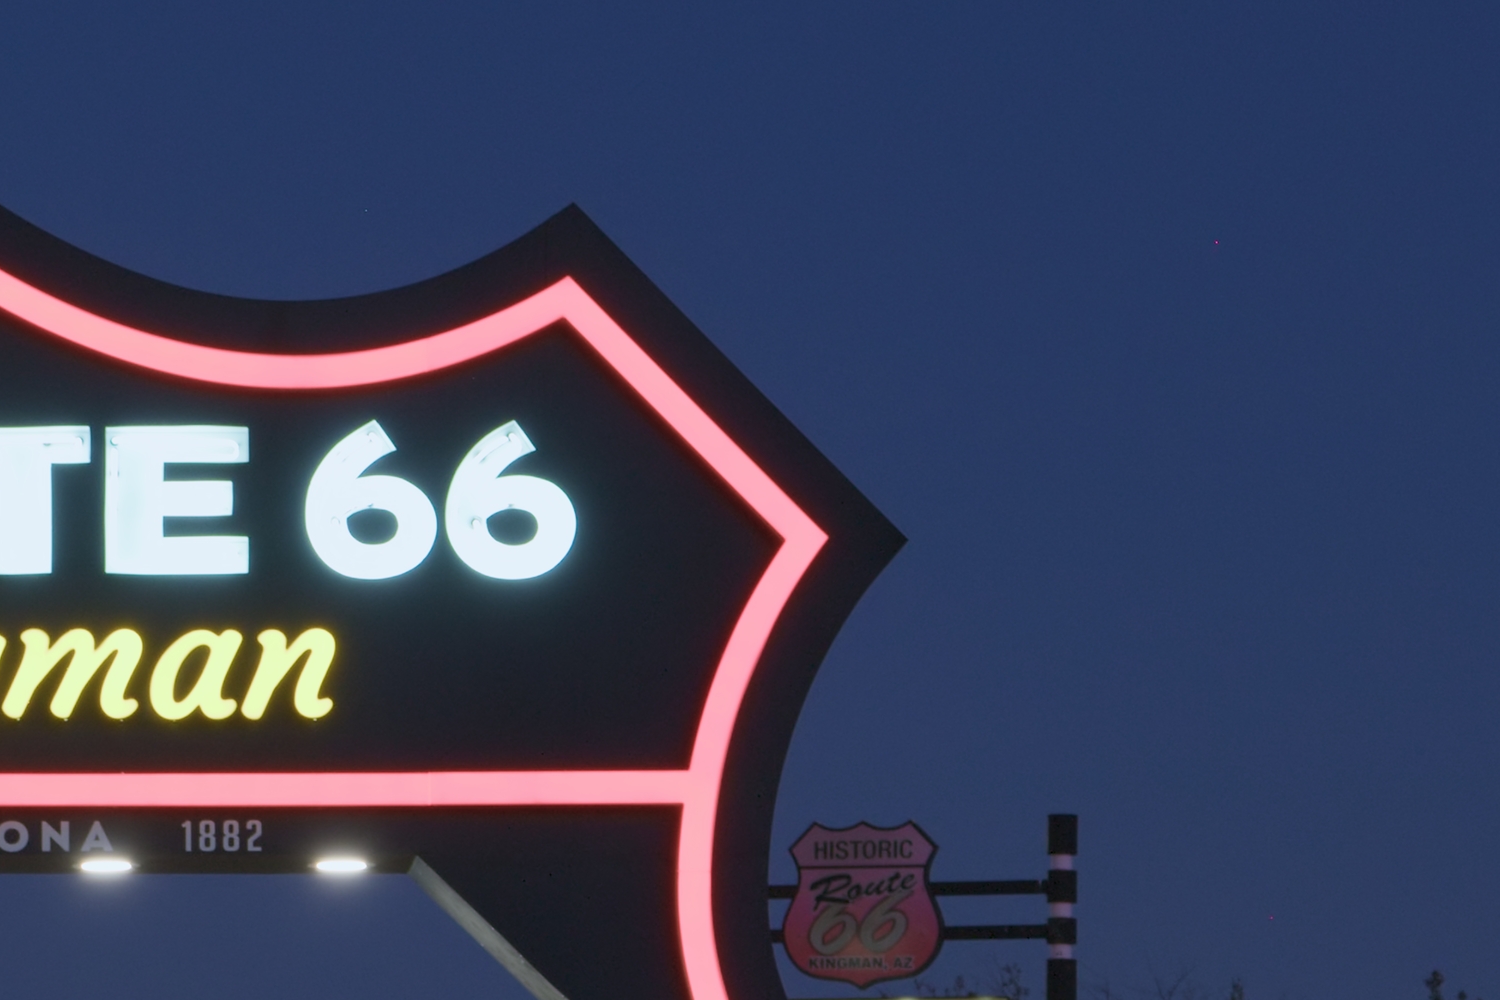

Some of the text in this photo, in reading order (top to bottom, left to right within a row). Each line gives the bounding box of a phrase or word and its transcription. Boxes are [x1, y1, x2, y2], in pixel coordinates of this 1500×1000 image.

[304, 419, 577, 580] 66
[180, 819, 264, 853] 1882
[813, 840, 913, 861] HISTORIC
[809, 872, 918, 912] Route
[808, 890, 916, 956] 66
[808, 956, 914, 971] KINGMAN, AZ
